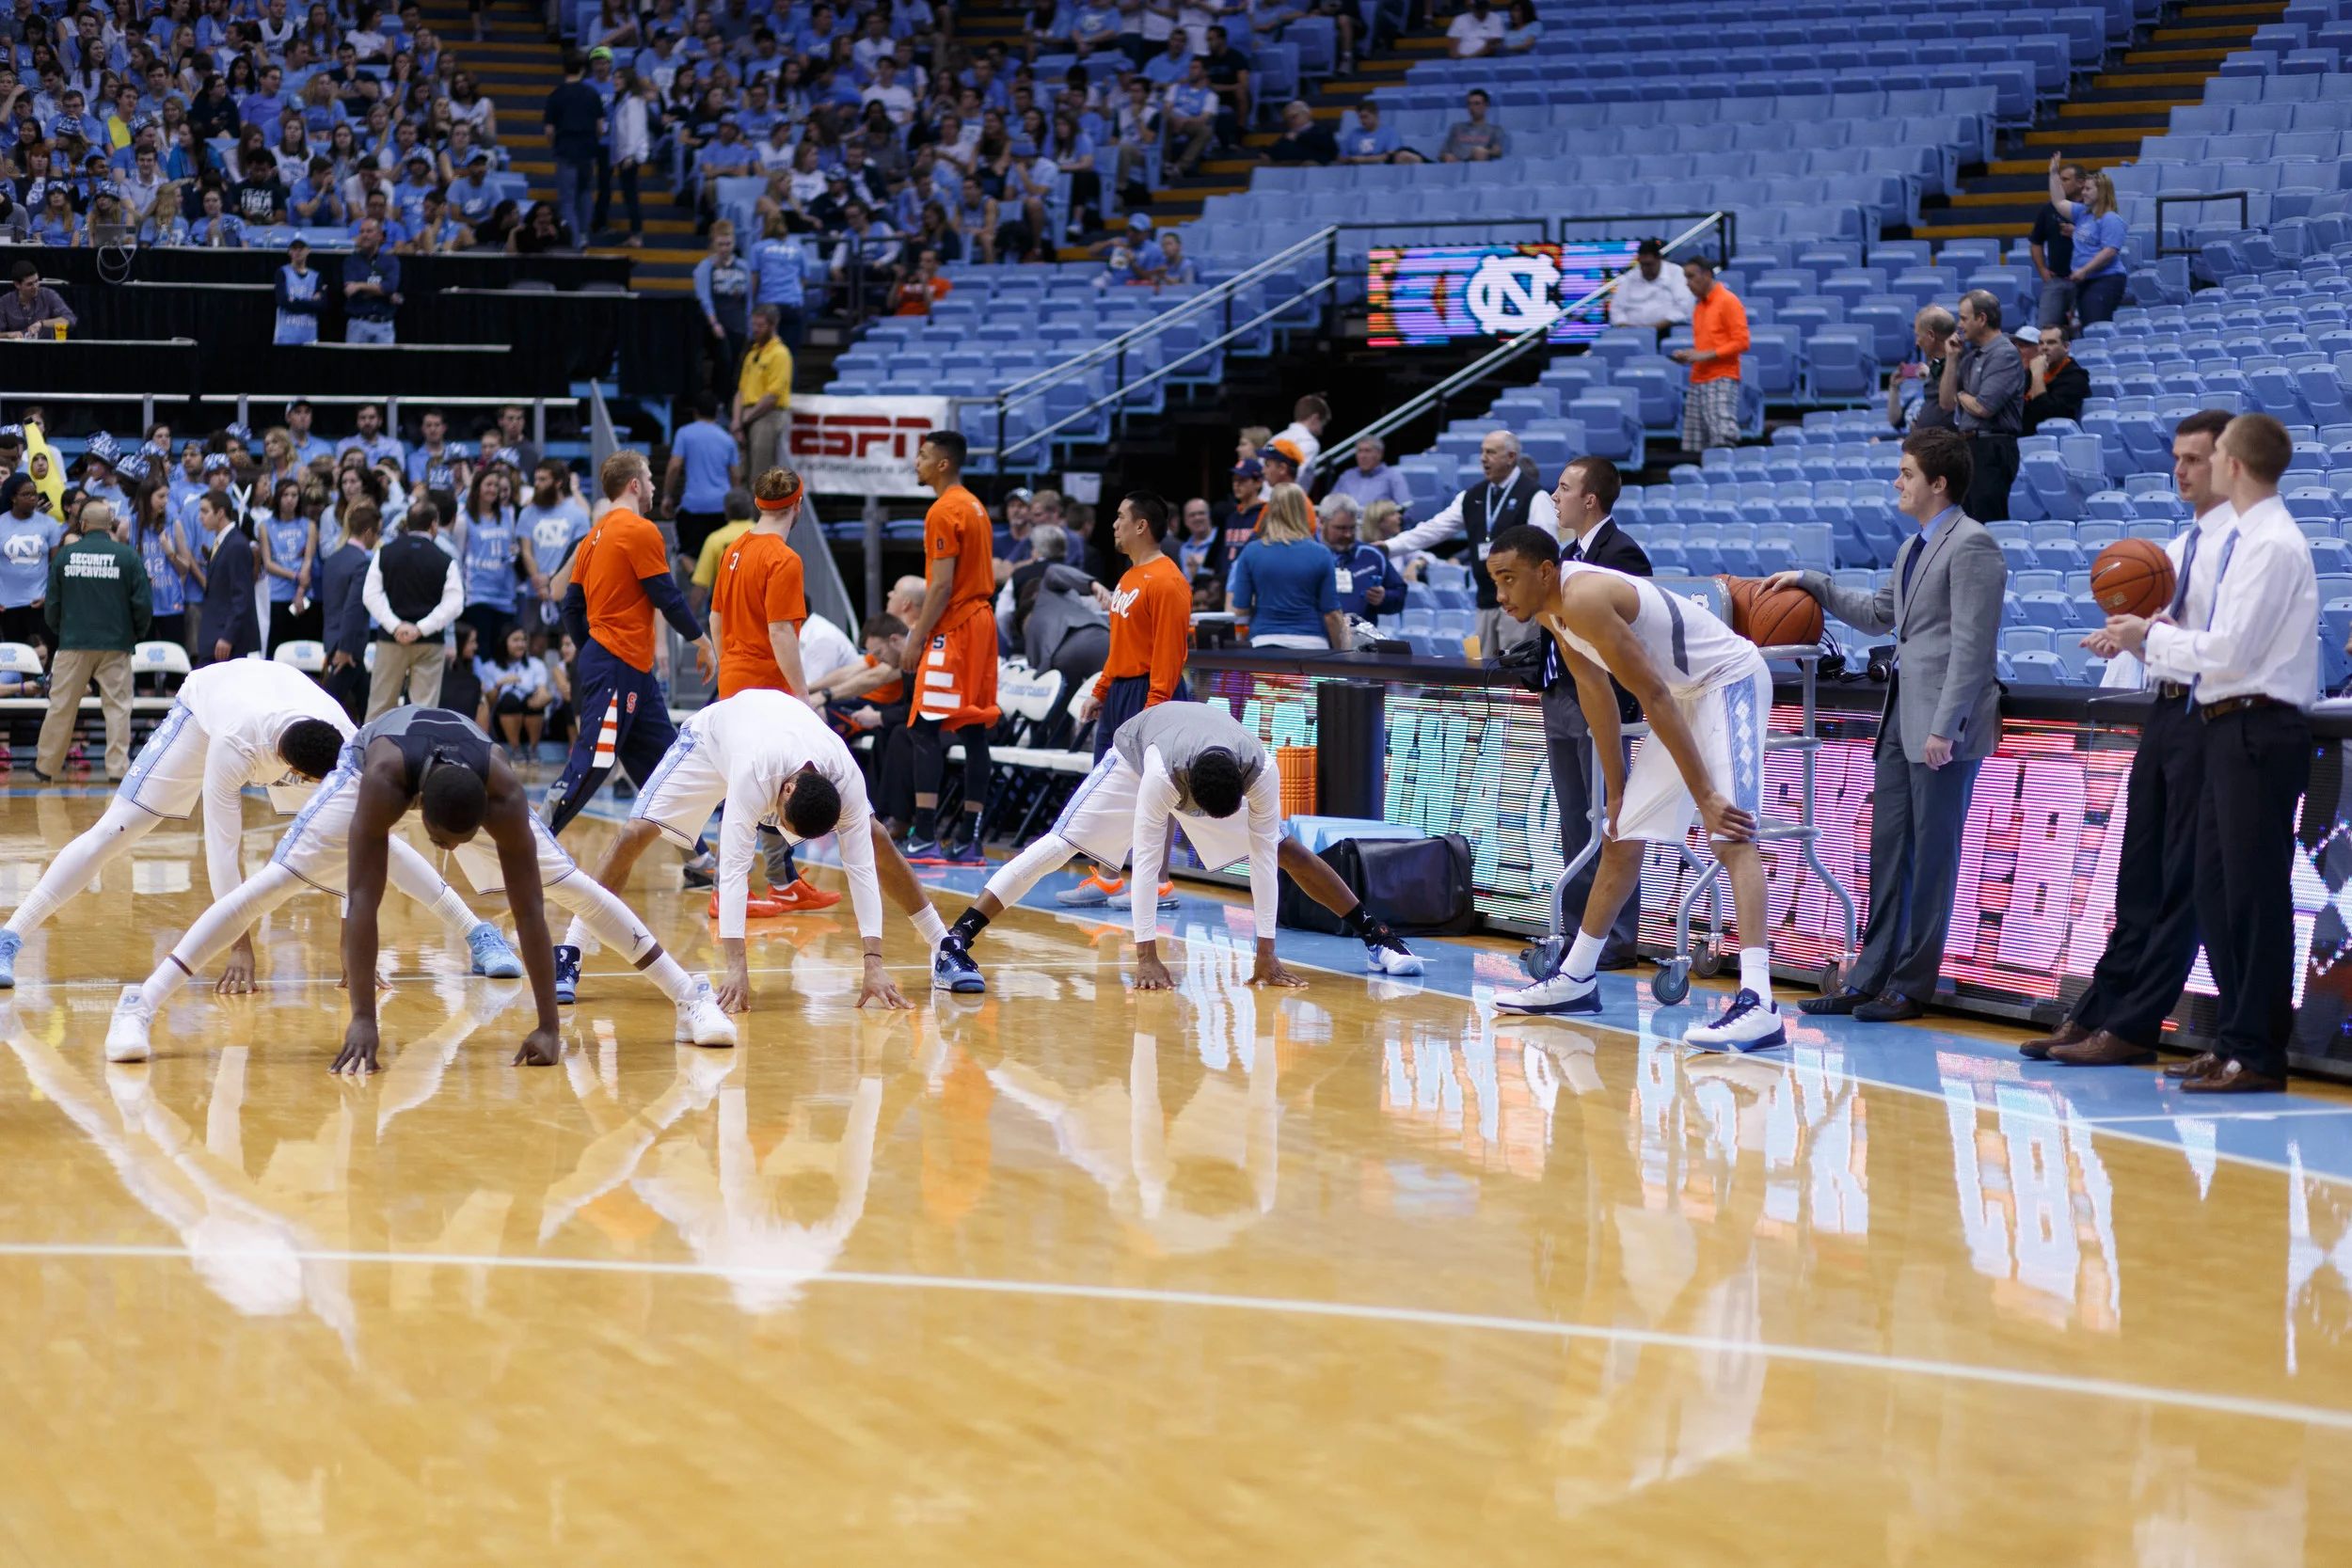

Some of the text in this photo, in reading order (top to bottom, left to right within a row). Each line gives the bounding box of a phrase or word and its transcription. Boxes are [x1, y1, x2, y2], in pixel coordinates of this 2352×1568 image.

[790, 413, 932, 458] ESPN
[70, 552, 116, 565] SECURITY
[64, 564, 120, 579] SUPERVISOR
